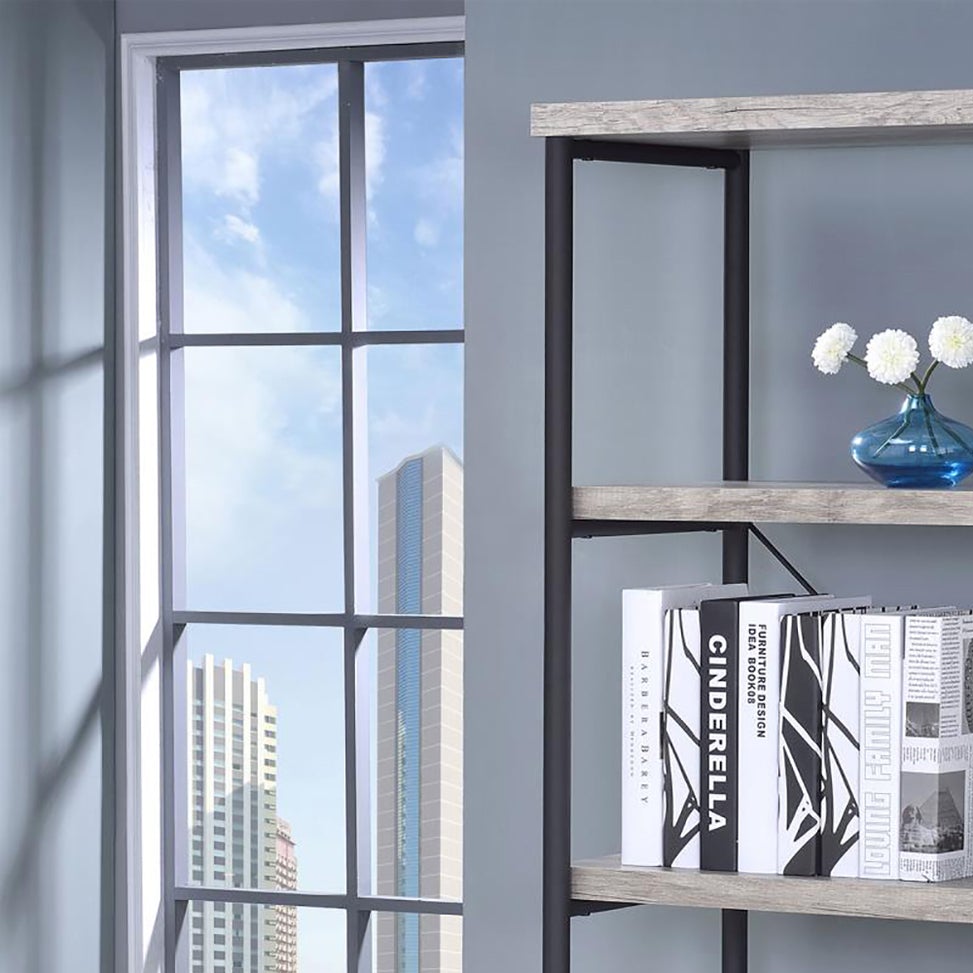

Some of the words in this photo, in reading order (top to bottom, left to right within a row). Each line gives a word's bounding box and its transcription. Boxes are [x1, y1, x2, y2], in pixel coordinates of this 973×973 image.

[747, 623, 757, 651] IDEA
[757, 623, 767, 690] FURNITURE
[863, 623, 892, 679] MAN
[747, 657, 757, 705] BOOK08
[707, 633, 728, 832] CINDERELLA
[756, 693, 766, 738] DESIGN
[863, 690, 892, 781] FAMILY
